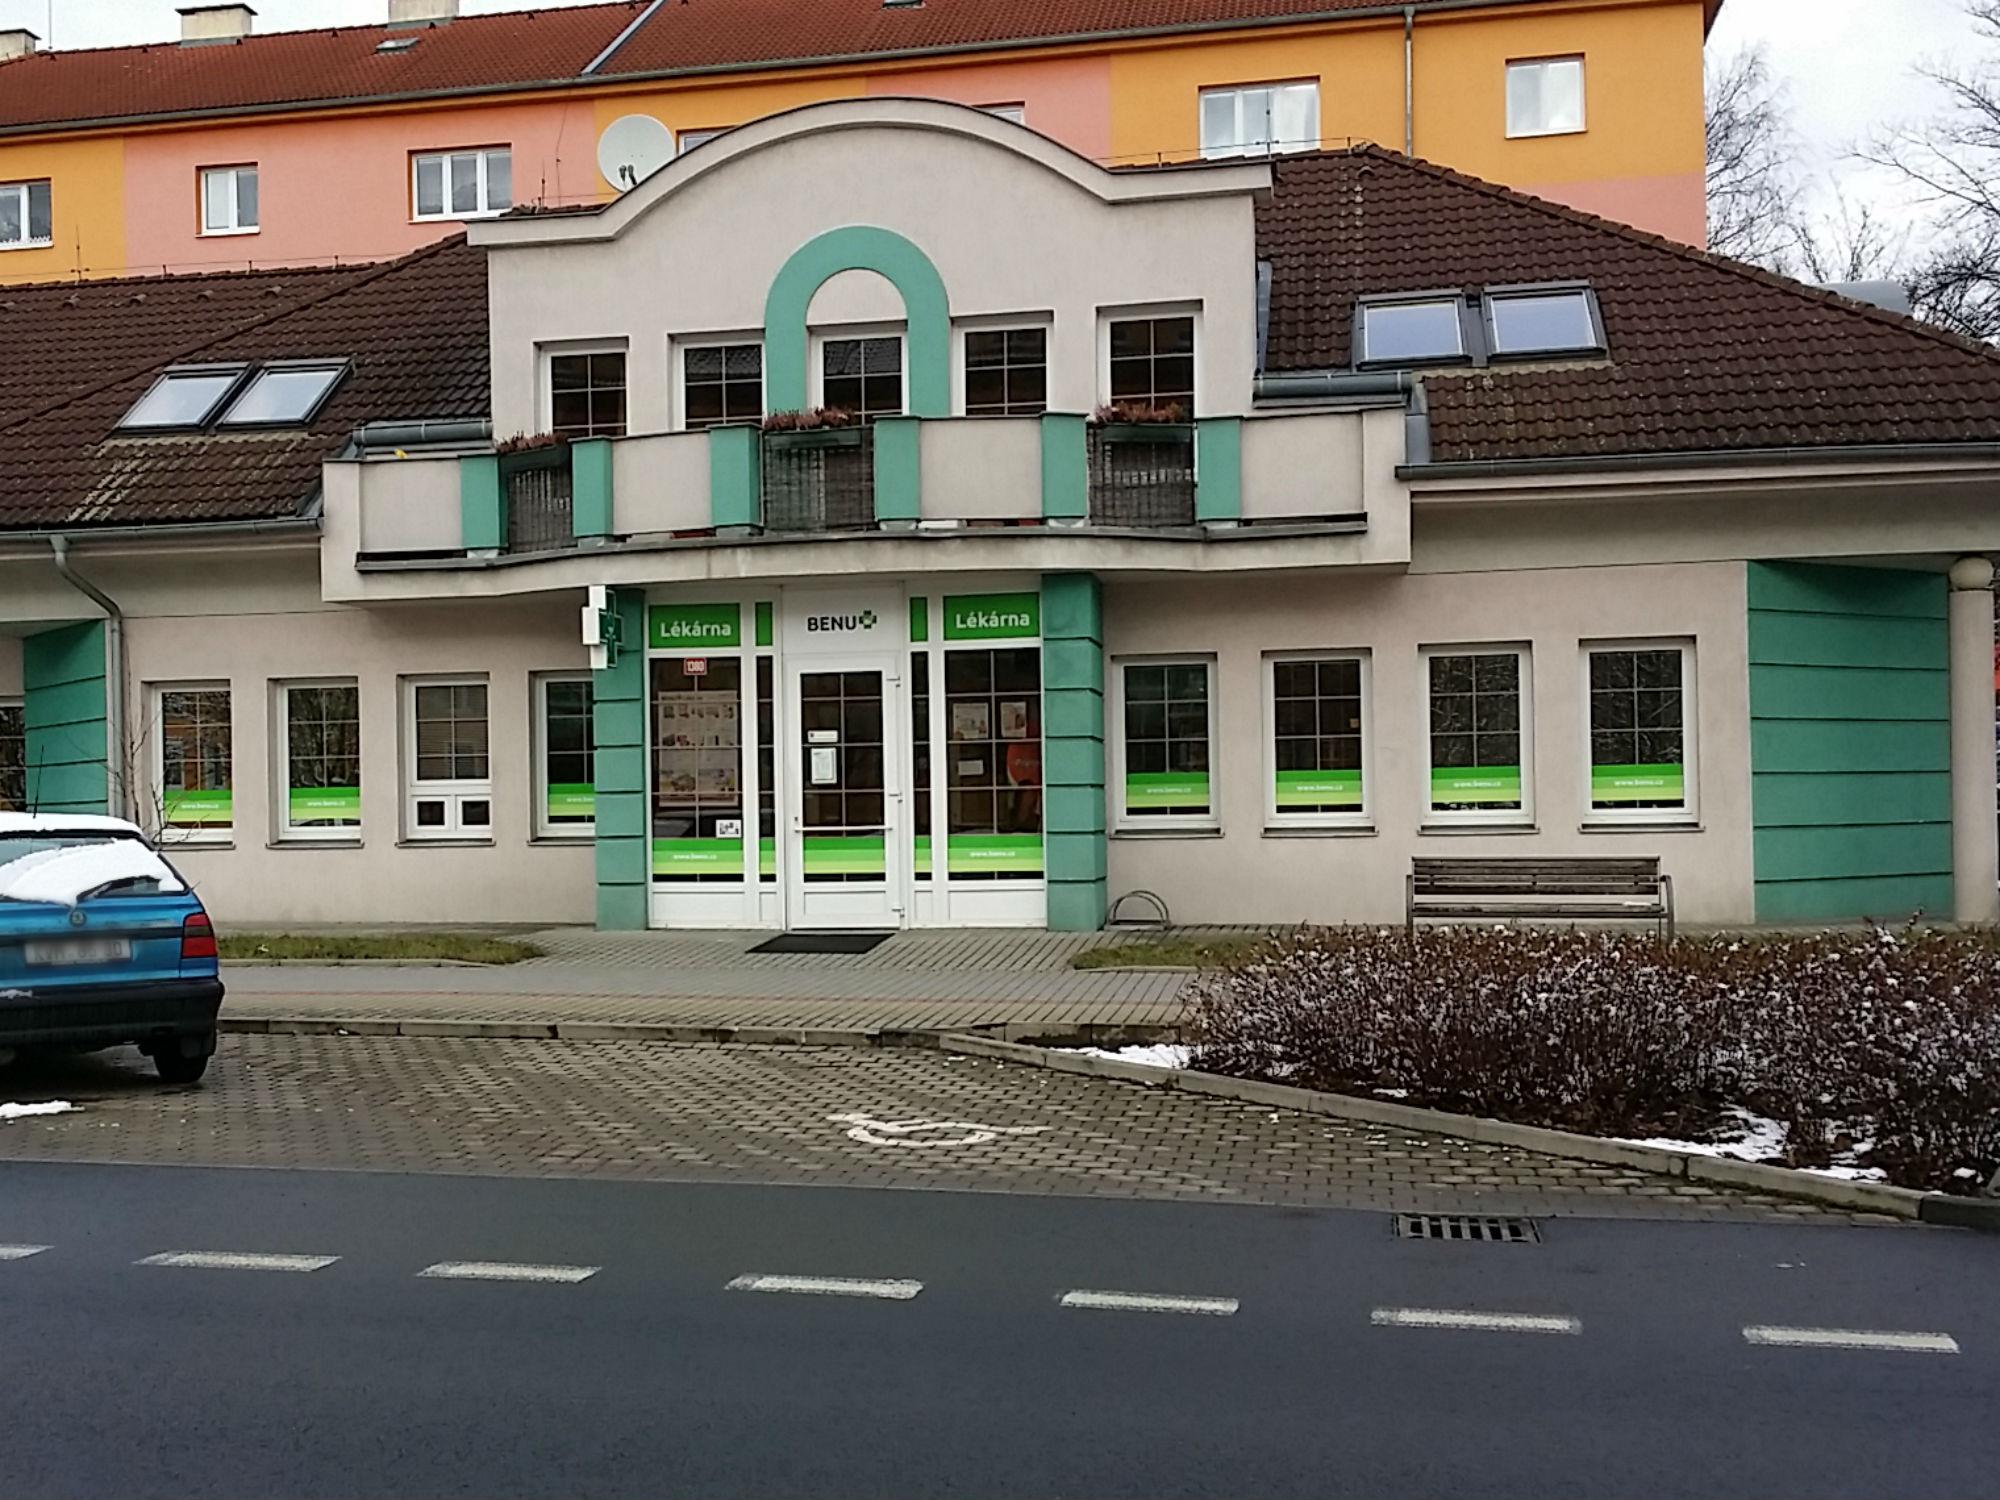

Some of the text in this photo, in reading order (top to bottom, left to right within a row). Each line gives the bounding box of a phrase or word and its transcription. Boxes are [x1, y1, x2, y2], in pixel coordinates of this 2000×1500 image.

[660, 620, 732, 638] Lékárna
[807, 616, 857, 632] BENU
[956, 611, 1031, 629] Lékárna
